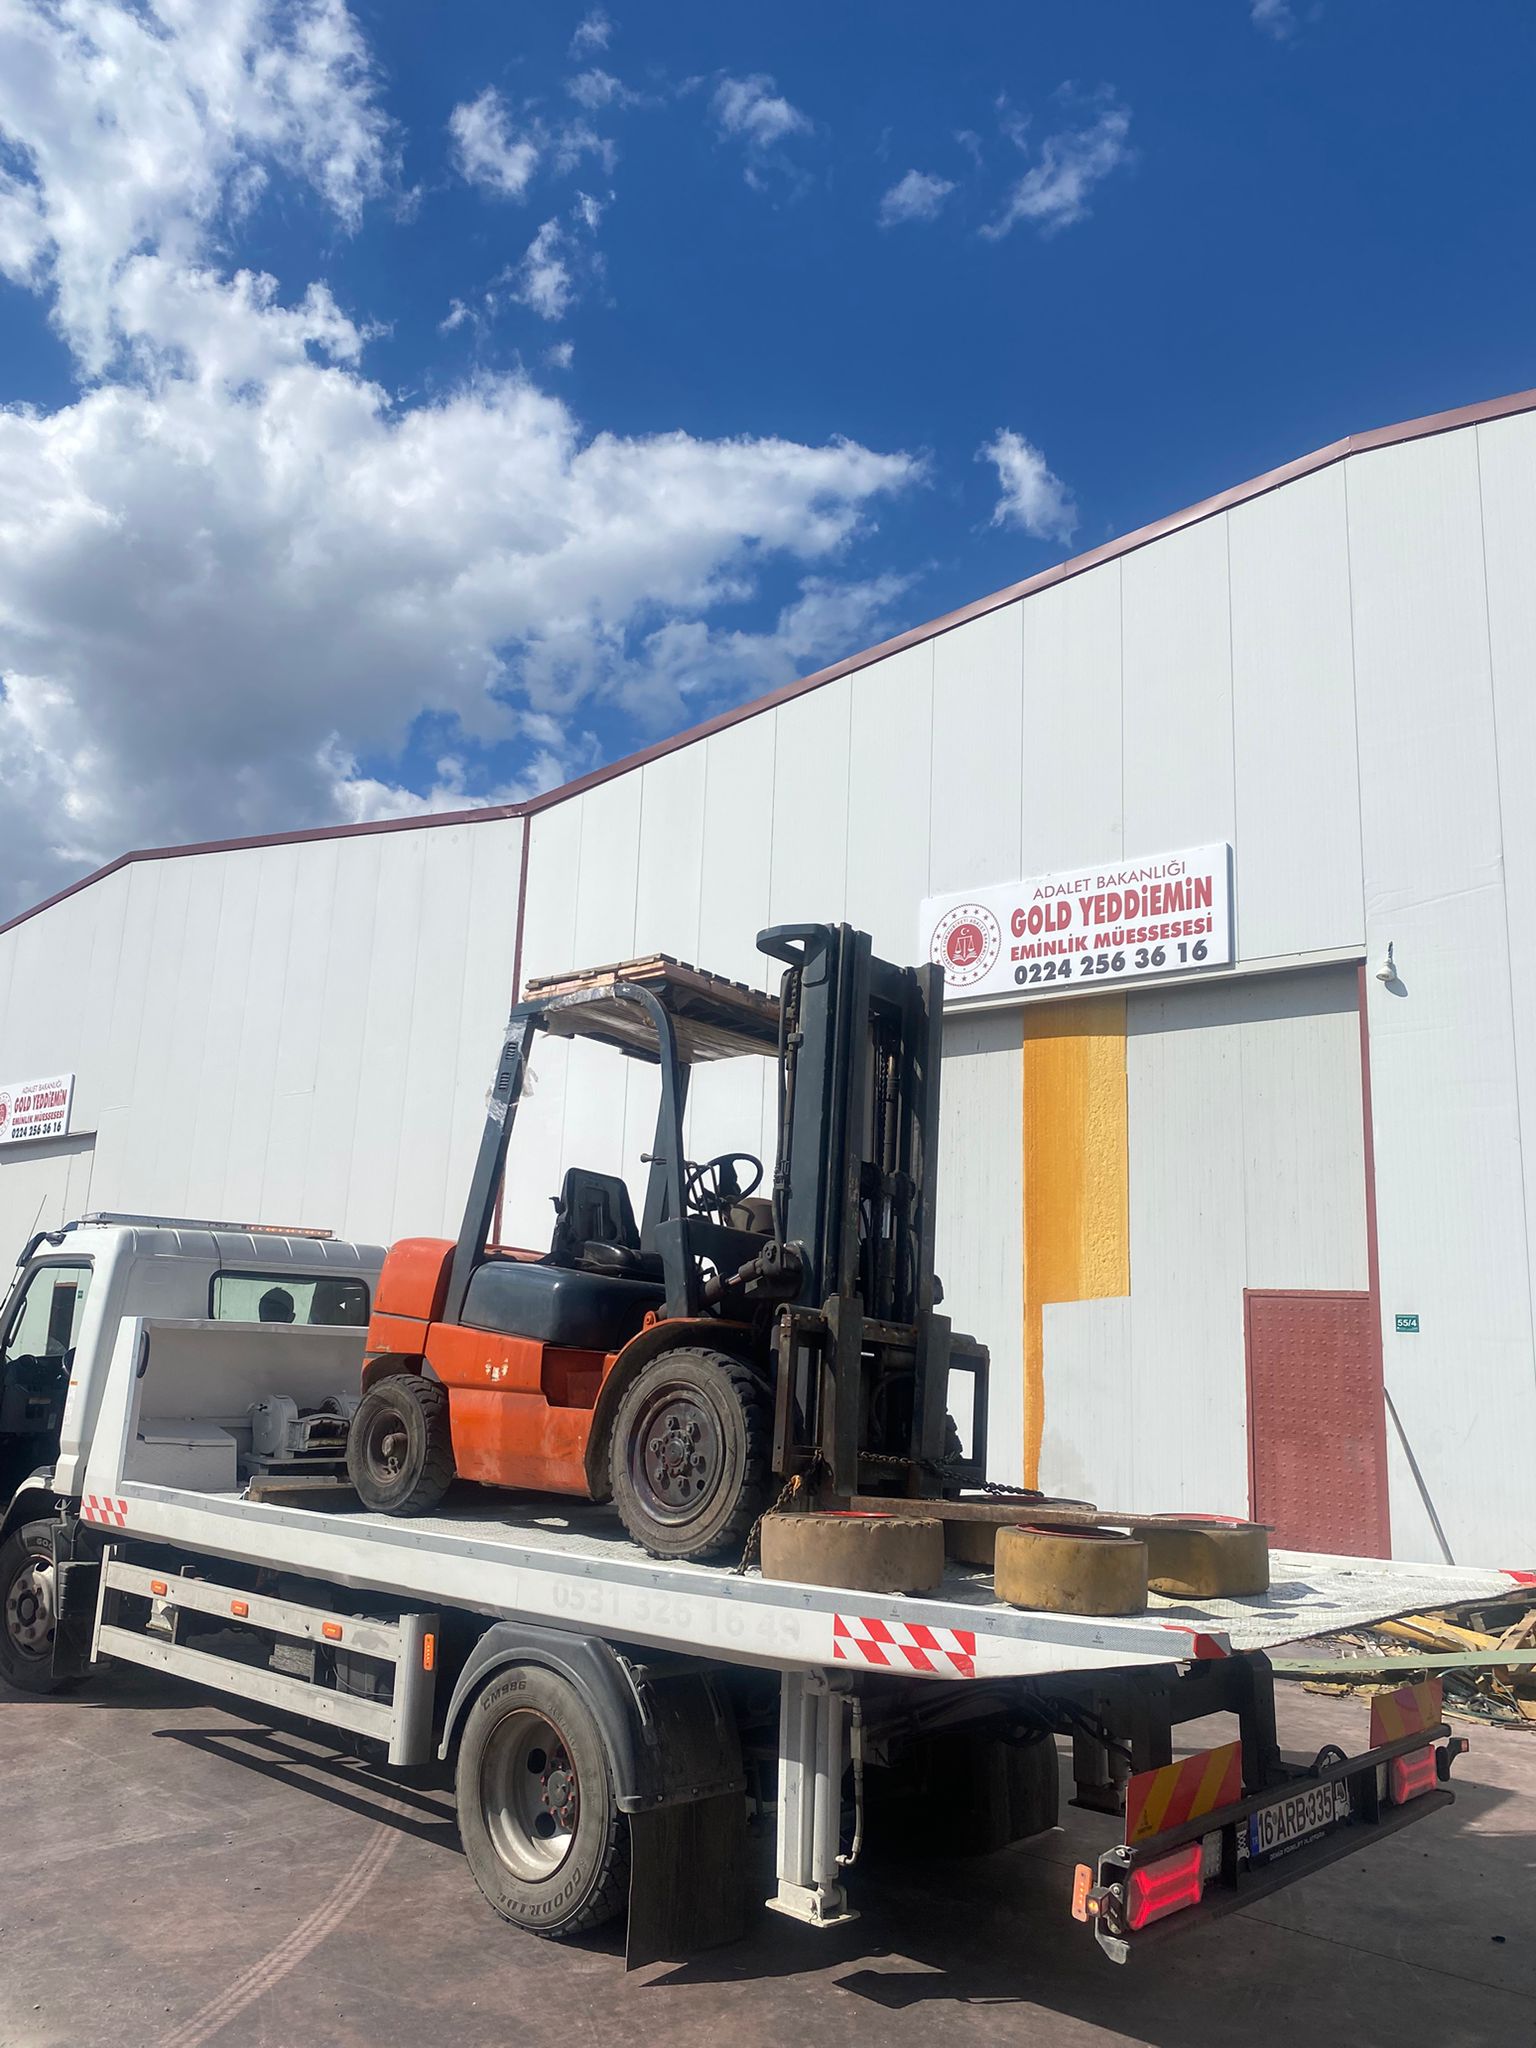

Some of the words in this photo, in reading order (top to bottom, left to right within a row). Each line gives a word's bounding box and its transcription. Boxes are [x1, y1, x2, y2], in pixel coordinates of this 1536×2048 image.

[1033, 878, 1091, 900] ADALET
[1097, 860, 1185, 889] BAKANLIĞI
[1011, 901, 1072, 938] GOLD
[1011, 933, 1088, 961] EMİNLİK
[1093, 912, 1212, 949] MÜESSESESİ
[1014, 958, 1072, 985] 0224
[1080, 951, 1126, 976] 256
[1134, 945, 1166, 969] 36
[1177, 939, 1208, 963] 16
[14, 1095, 31, 1113] GOLD
[11, 1127, 28, 1139] 0224
[29, 1124, 42, 1137] 256
[42, 1122, 52, 1134] 36
[53, 1121, 62, 1133] 16
[551, 1578, 621, 1617] 0531
[632, 1591, 693, 1629] 326
[705, 1598, 745, 1637] 16
[1258, 1811, 1274, 1848] 16
[1277, 1797, 1306, 1841] ARB
[1308, 1786, 1332, 1826] 335
